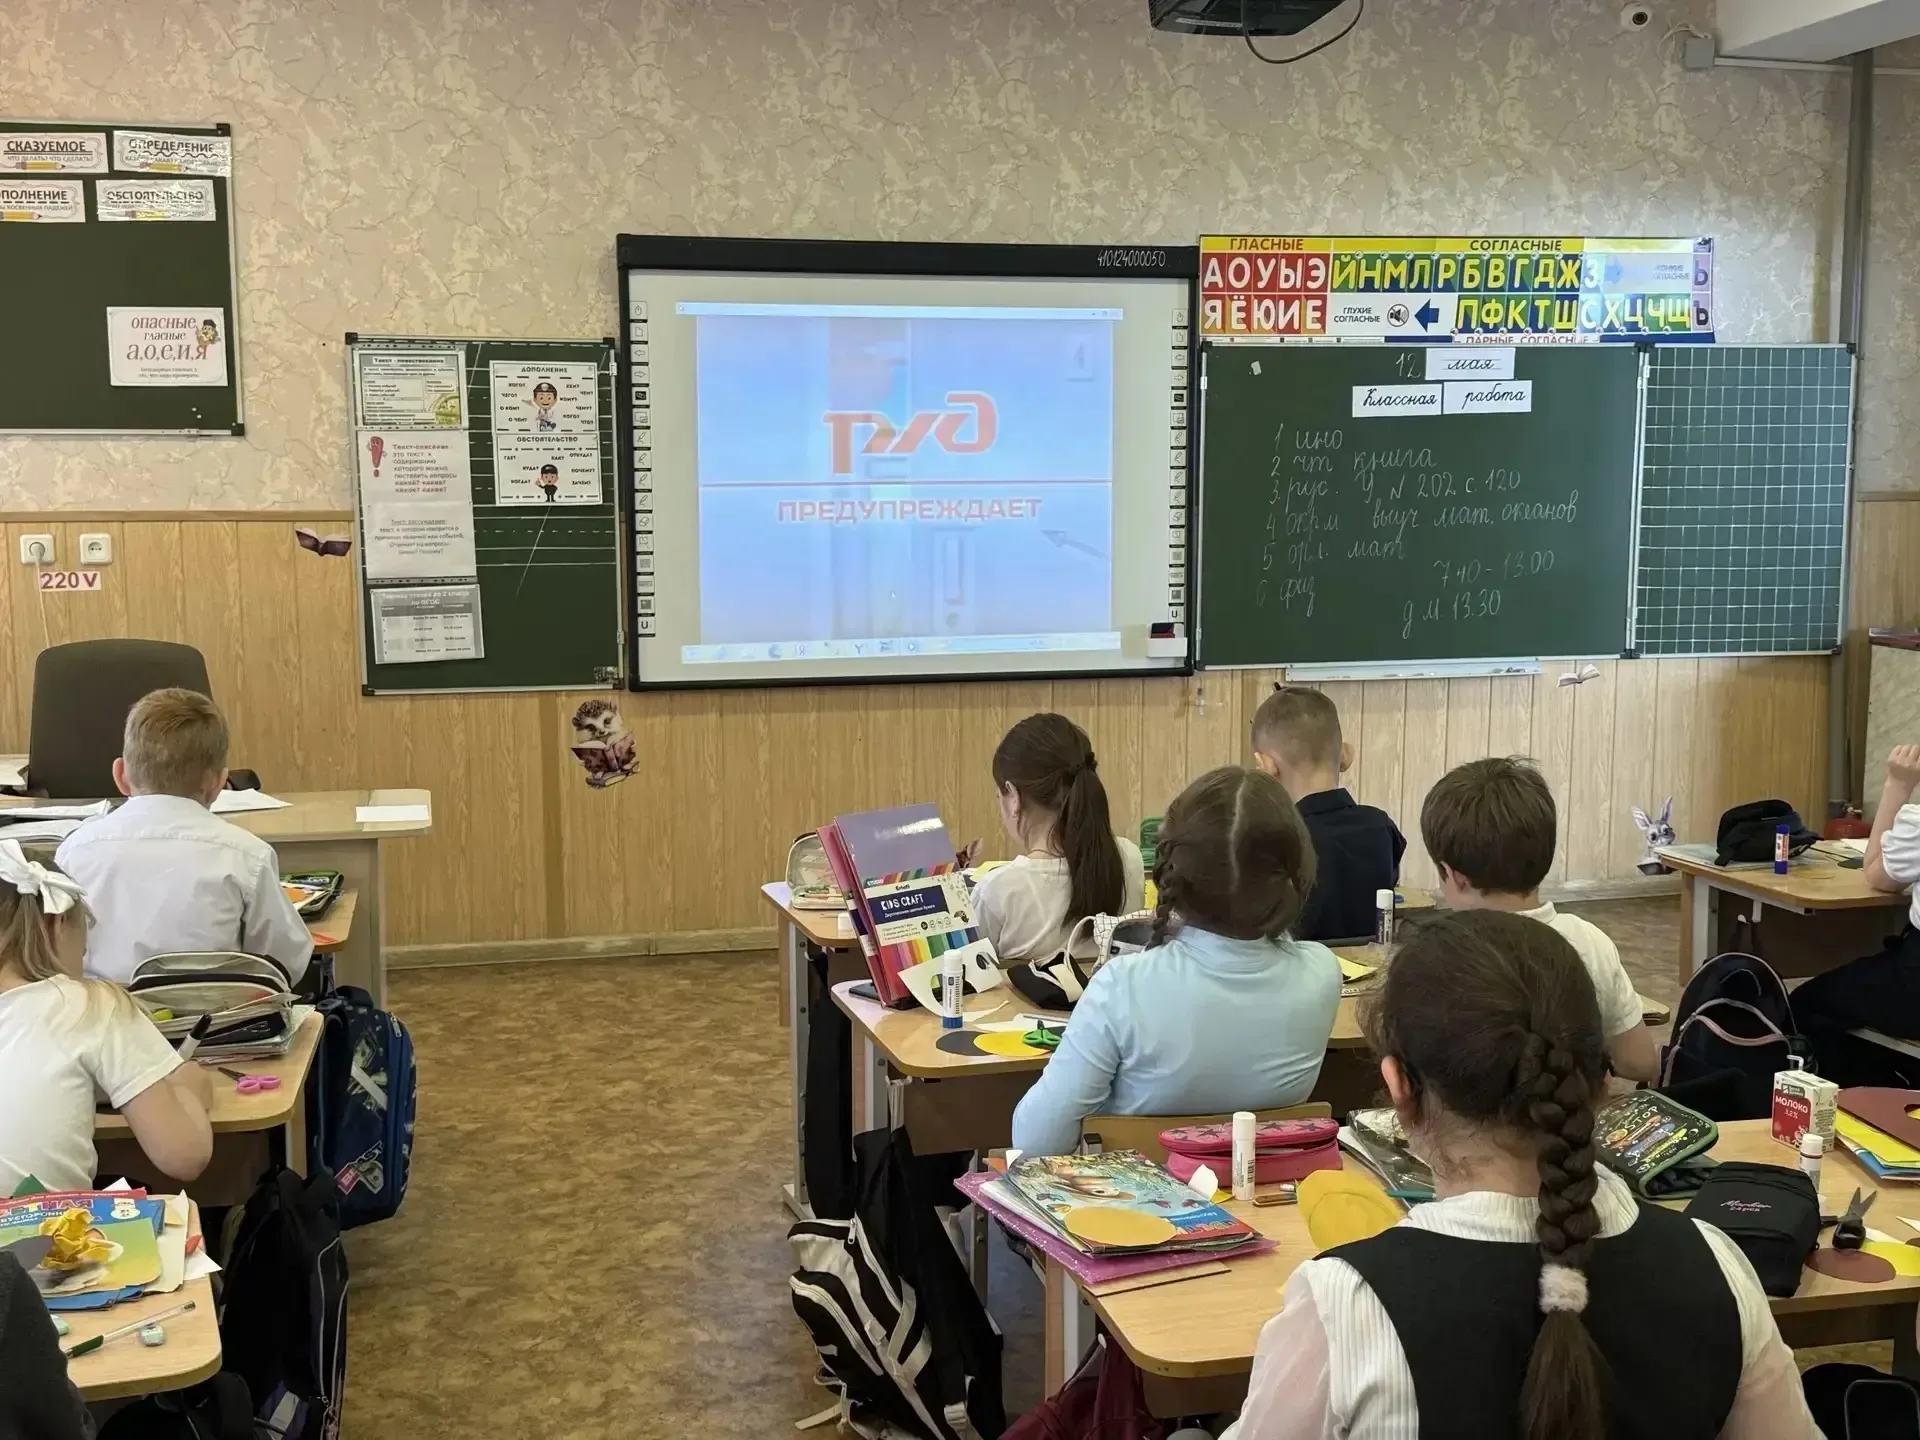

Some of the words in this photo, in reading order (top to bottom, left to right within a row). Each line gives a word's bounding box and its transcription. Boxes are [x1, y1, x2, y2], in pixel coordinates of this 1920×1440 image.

[7, 140, 87, 152] СКАЗУЕМОЕ
[0, 190, 68, 200] ПОЛНЕНИЕ
[1229, 238, 1304, 250] ГЛАСНЫЕ
[1470, 239, 1562, 251] СОГЛАСНЫЕ
[1333, 315, 1381, 323] СОГЛАСНЫЕ
[1343, 307, 1372, 315] ГЛУХИЕ
[131, 317, 196, 329] опасные
[144, 332, 186, 341] гласные
[1395, 353, 1421, 379] 12
[1447, 359, 1496, 370] мая
[1362, 388, 1438, 407] Классная
[1461, 383, 1526, 410] работа
[1270, 456, 1281, 477] 2
[1353, 449, 1437, 471] книга
[1417, 472, 1457, 498] 202
[1485, 469, 1521, 491] 120
[778, 499, 1043, 524] ПРЕДУПРЕЖДАЕТ
[1502, 489, 1579, 523] океанов
[1263, 542, 1276, 571] 5
[41, 573, 80, 589] 220
[83, 573, 98, 587] V
[1452, 588, 1501, 621] 13.30
[880, 898, 900, 911] KIDS
[900, 893, 924, 906] CRAFT
[1775, 1095, 1808, 1114] МОЛОКО
